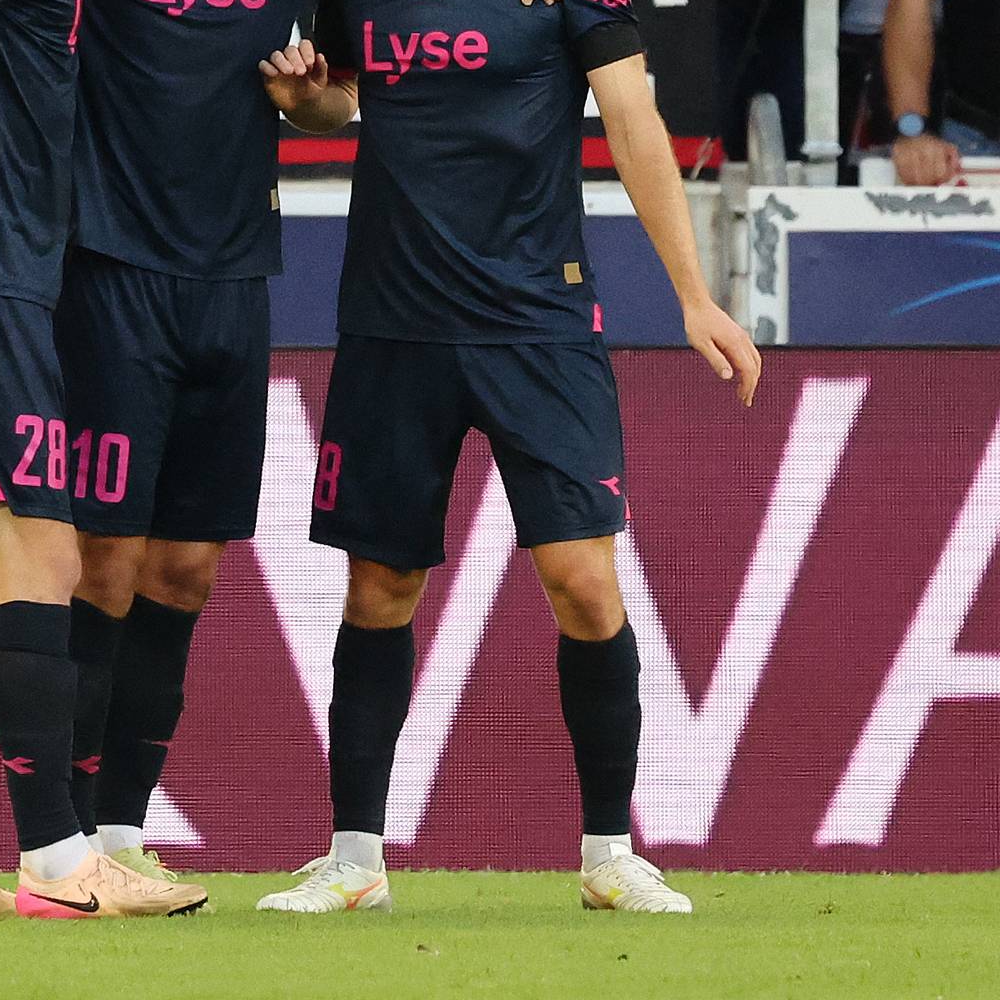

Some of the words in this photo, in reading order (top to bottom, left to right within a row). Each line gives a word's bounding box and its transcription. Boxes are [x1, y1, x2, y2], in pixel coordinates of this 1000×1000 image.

[363, 20, 489, 85] Lyse
[12, 414, 66, 490] 28
[72, 429, 130, 503] 10
[314, 440, 342, 511] 8
